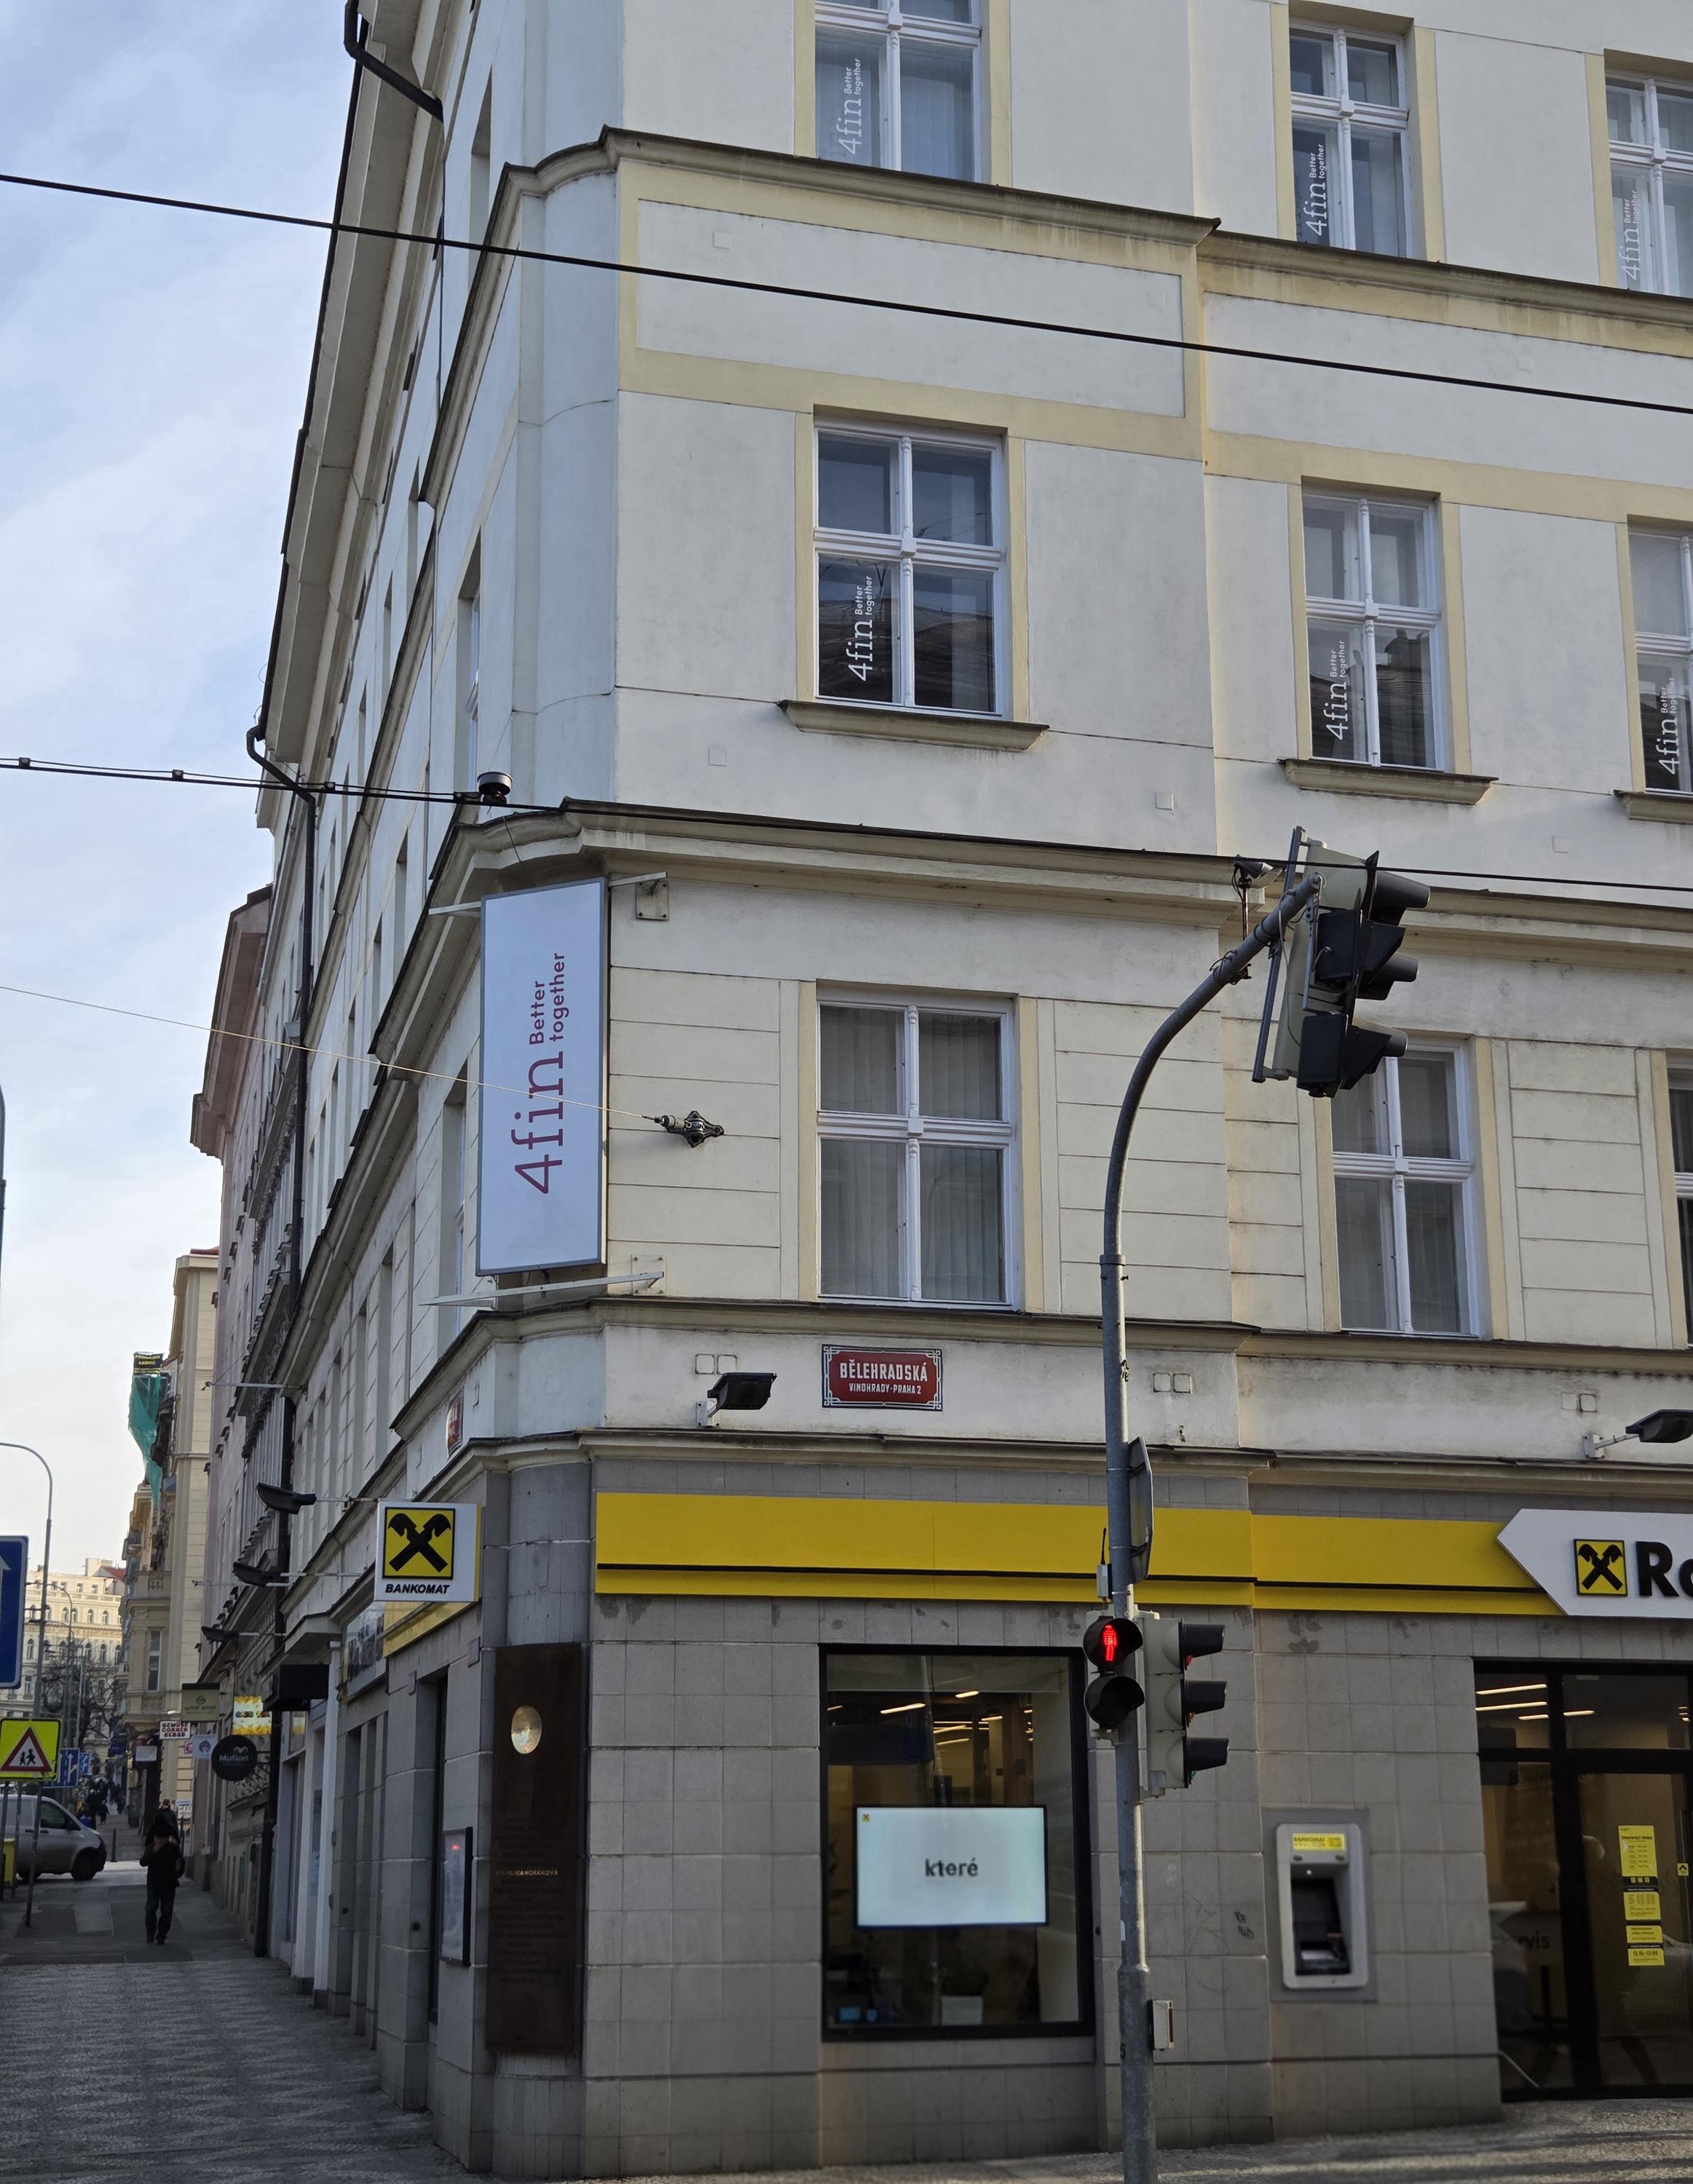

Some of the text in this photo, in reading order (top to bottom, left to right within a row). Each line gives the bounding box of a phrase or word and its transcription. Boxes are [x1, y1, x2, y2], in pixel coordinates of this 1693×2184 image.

[844, 66, 853, 94] Better
[853, 58, 864, 95] together
[836, 99, 862, 154] 4fin
[1317, 144, 1327, 179] together
[1303, 182, 1327, 236] 4fin
[1619, 227, 1641, 280] 4fin
[855, 585, 863, 615] Better
[864, 576, 875, 616] together
[845, 620, 873, 681] 4fin
[1338, 640, 1348, 678] together
[1323, 681, 1349, 740] 4fin
[1660, 687, 1668, 713] Better
[1655, 717, 1680, 775] 4fin
[529, 980, 545, 1045] Better
[549, 952, 569, 1042] together
[510, 1051, 564, 1195] 4fin
[840, 1359, 928, 1382] BĚLEHRADSKÁ
[917, 1385, 922, 1395] 2
[385, 1583, 450, 1594] BANKOMAT
[925, 1857, 979, 1877] které
